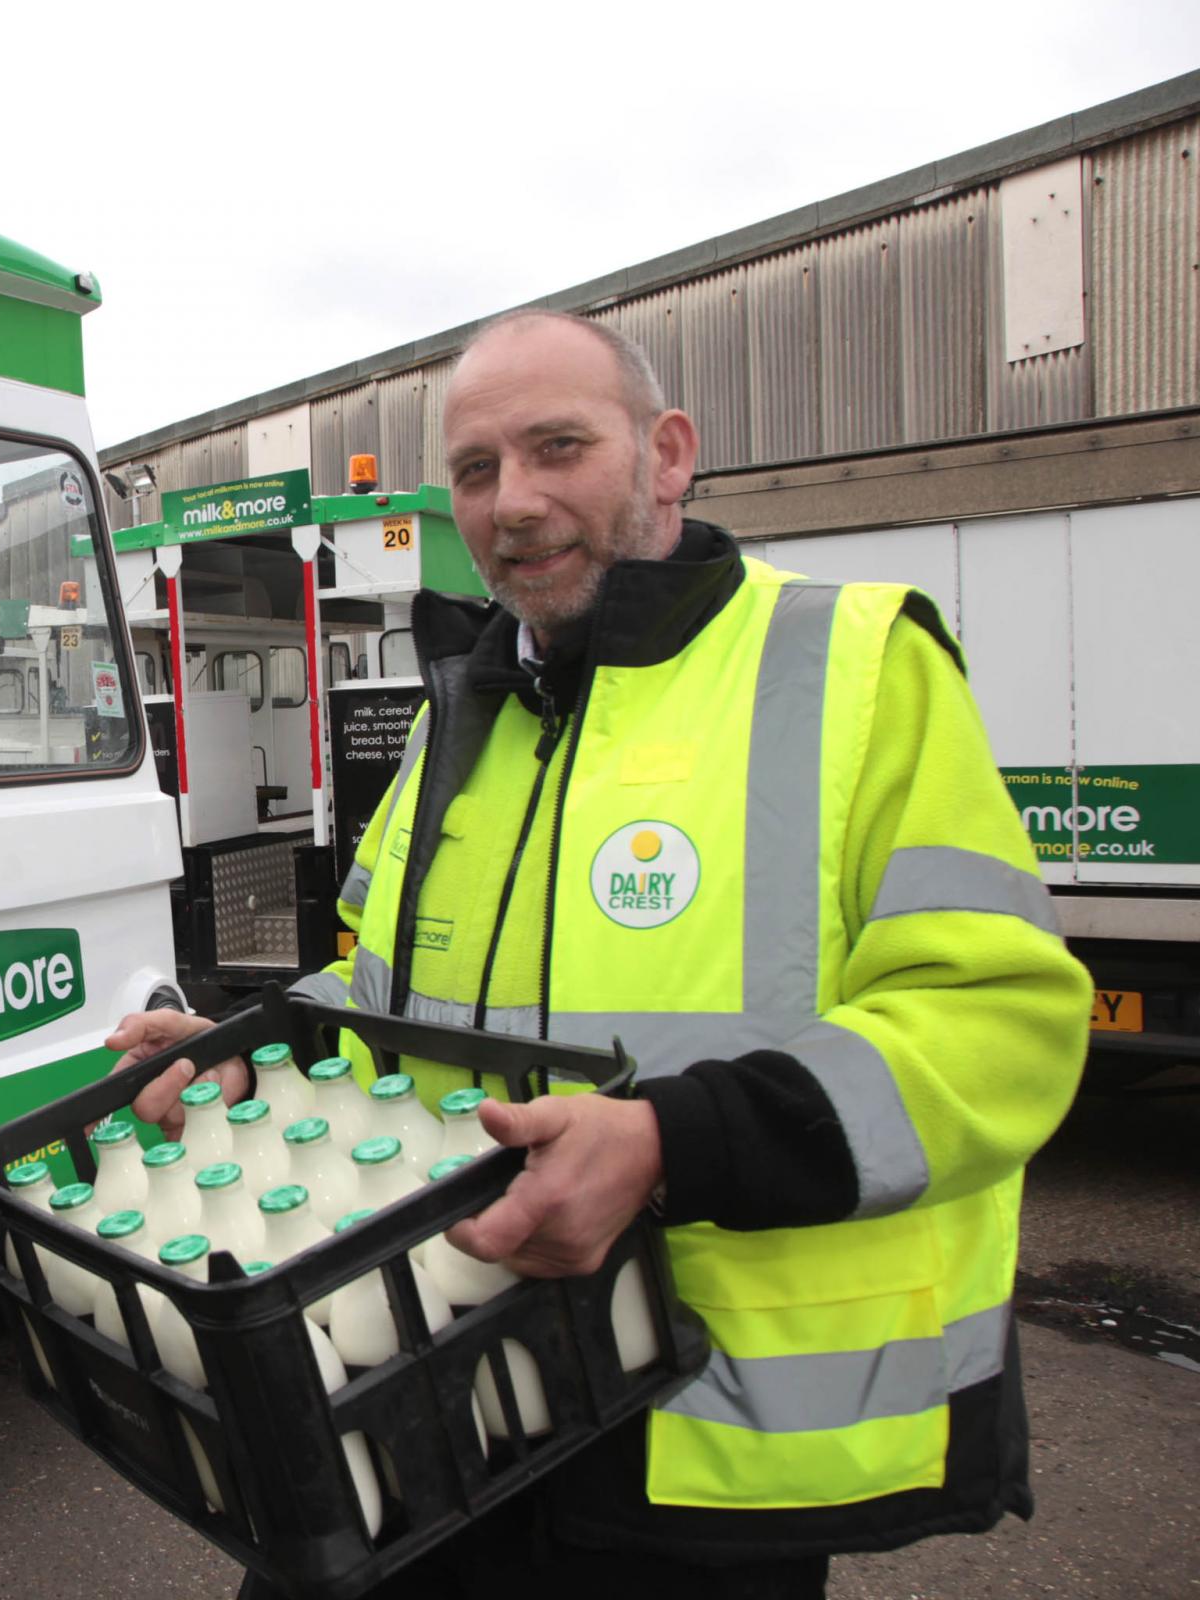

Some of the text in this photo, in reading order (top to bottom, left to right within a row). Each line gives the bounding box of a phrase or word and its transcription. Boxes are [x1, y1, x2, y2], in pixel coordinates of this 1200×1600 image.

[249, 481, 264, 489] now
[183, 495, 286, 526] milk&more
[178, 513, 294, 539] www.milkandmore.co.uk
[384, 528, 410, 548] 20
[63, 634, 79, 648] 23
[354, 704, 414, 717] milk, cereal,
[343, 719, 413, 734] juice, smoothi
[351, 735, 385, 746] bread,
[345, 750, 385, 760] cheese,
[1000, 773, 1139, 790] kman is now online
[1021, 805, 1141, 832] more
[1033, 840, 1155, 856] more.co.uk
[610, 872, 676, 896] DAIRY
[608, 896, 675, 910] CREST
